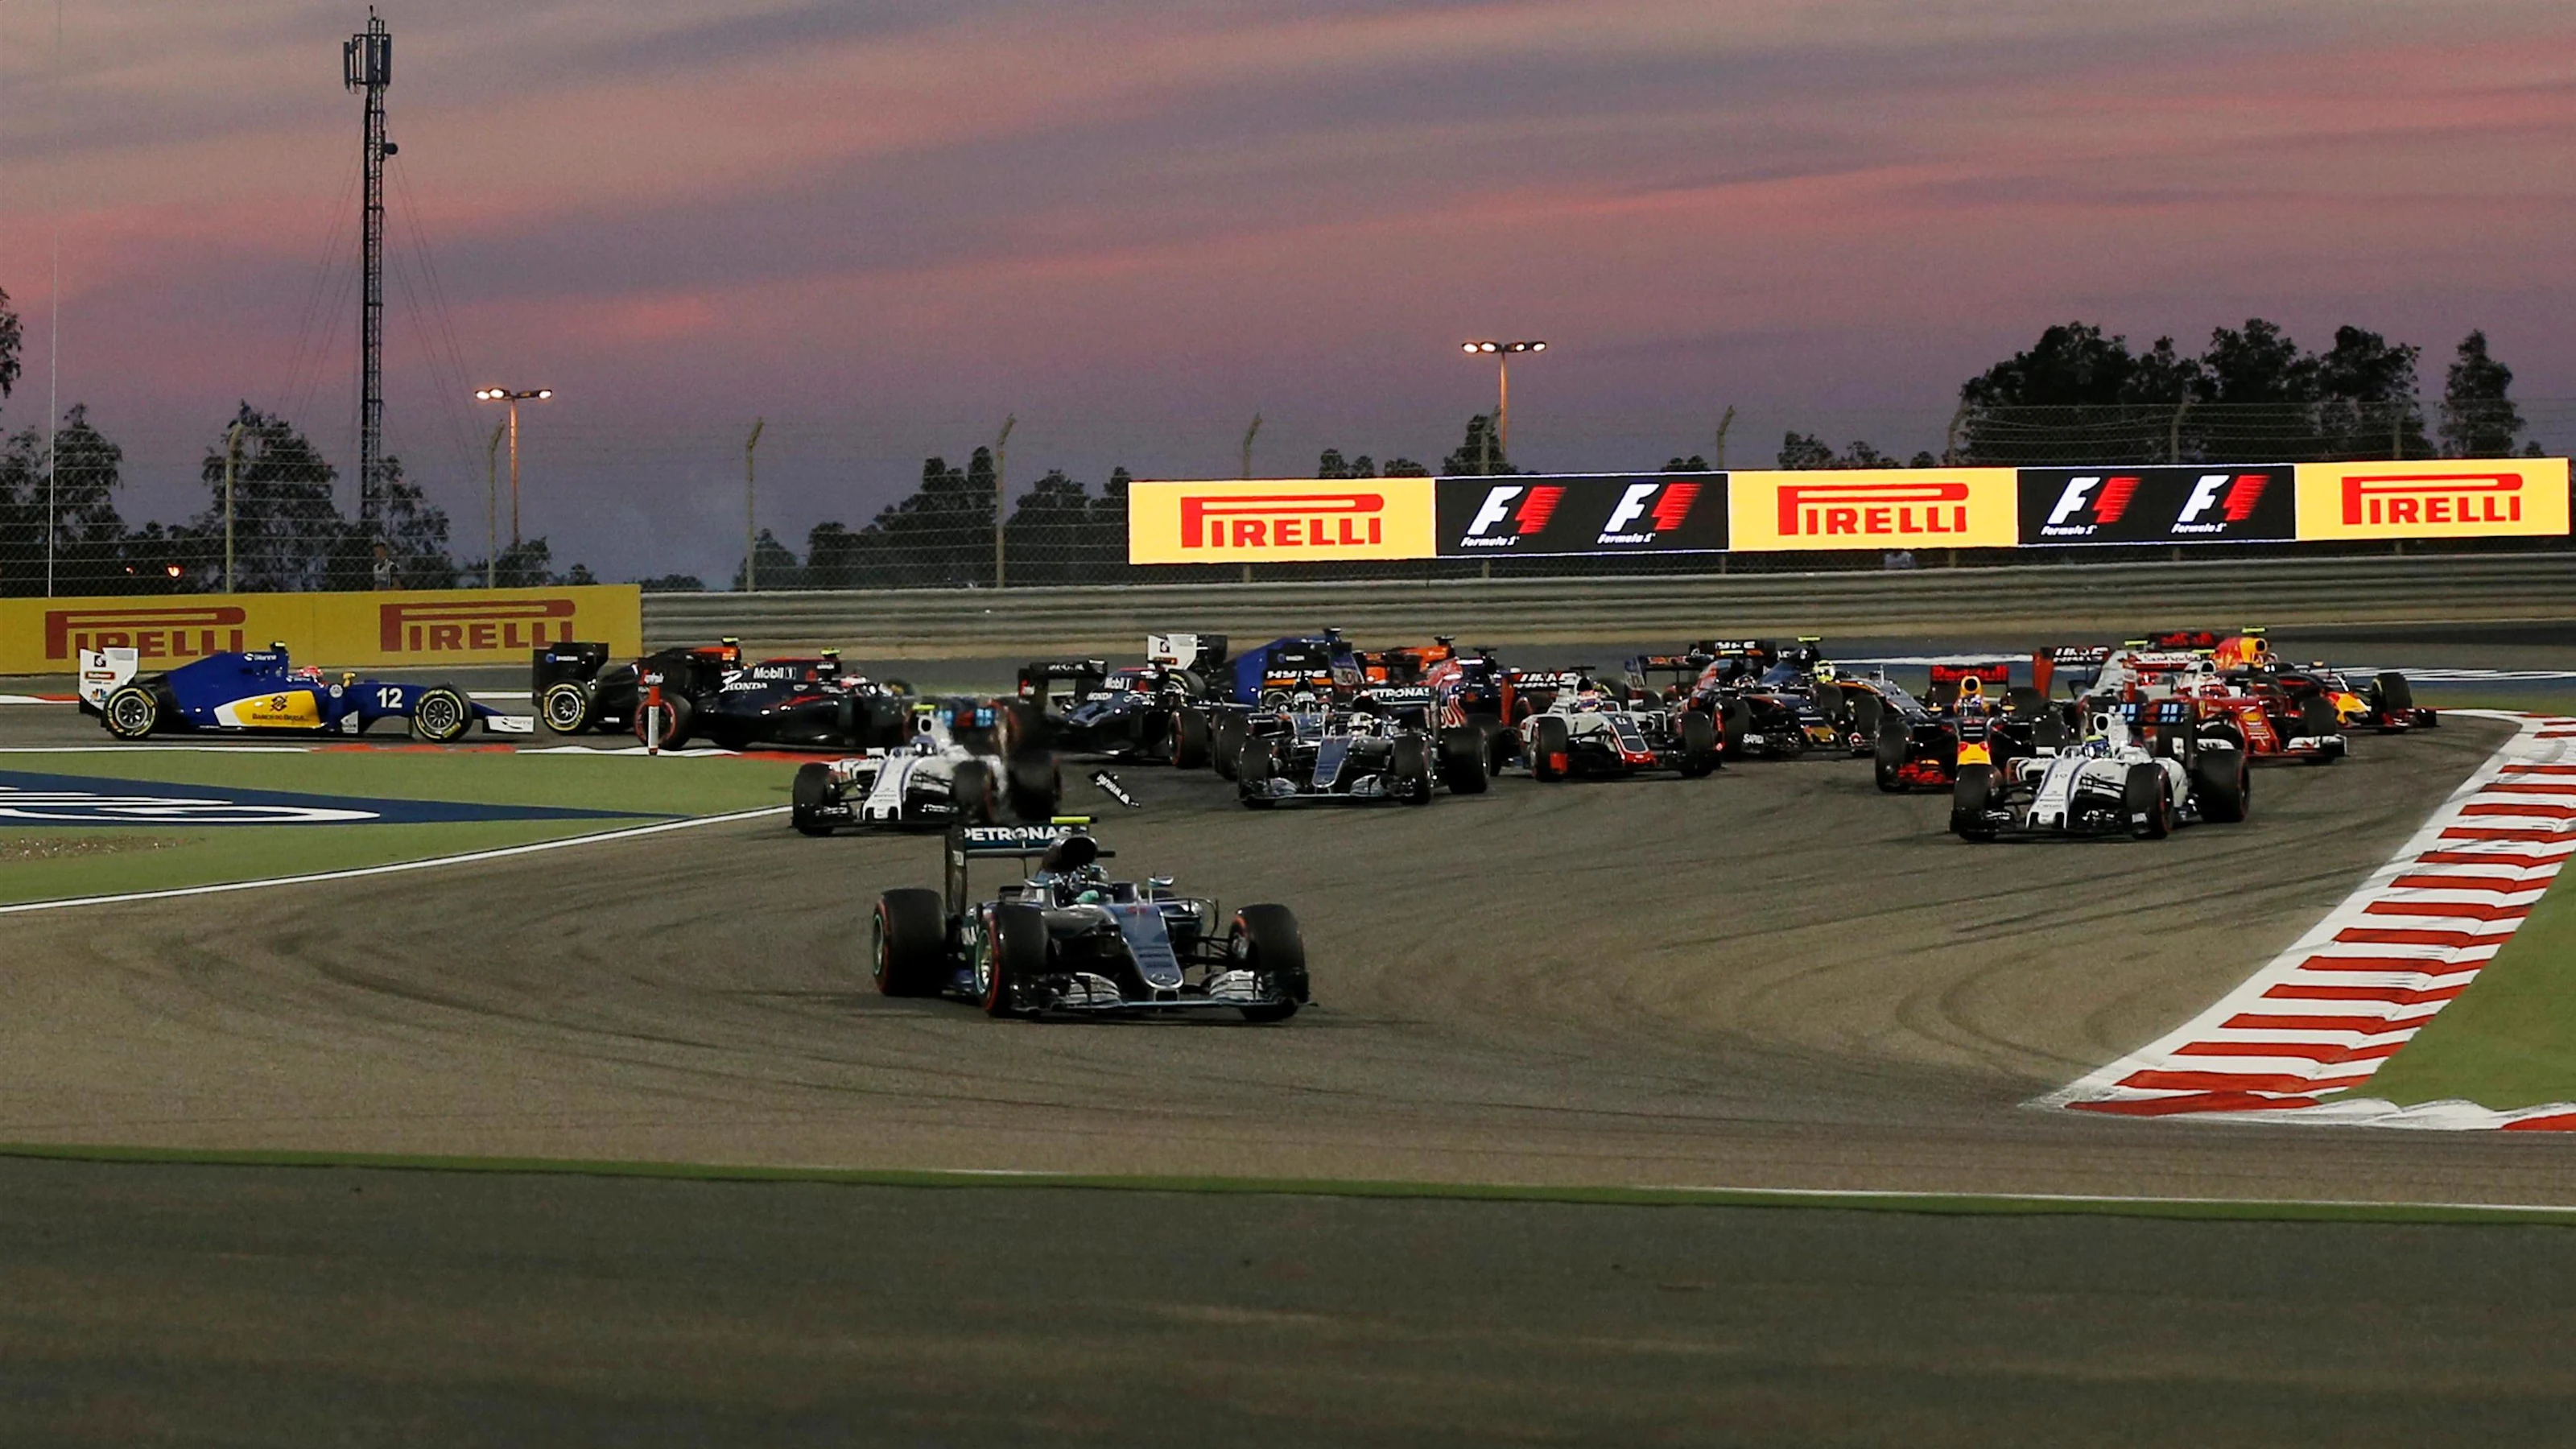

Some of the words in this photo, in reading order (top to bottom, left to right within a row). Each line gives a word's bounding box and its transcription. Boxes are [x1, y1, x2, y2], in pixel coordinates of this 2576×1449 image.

[1180, 493, 1385, 548] PIRELLI
[1777, 482, 1969, 535] PIRELLI
[2341, 473, 2523, 523] PIRELLI
[1460, 536, 1507, 547] Formula
[45, 606, 246, 659] PIRELLI
[380, 599, 576, 651] PIRELLI
[376, 687, 402, 708] 12
[753, 667, 784, 679] Mobil
